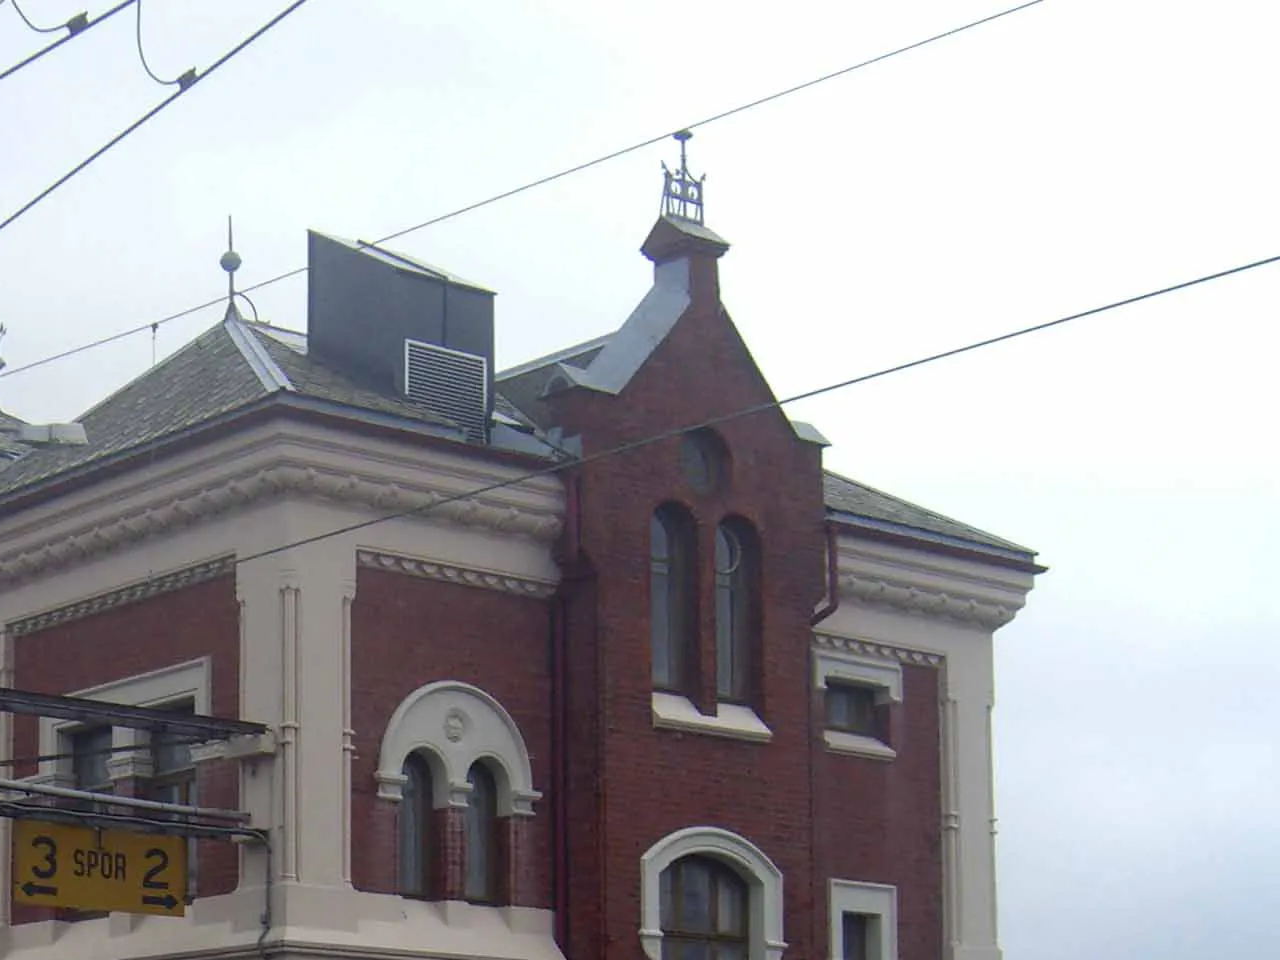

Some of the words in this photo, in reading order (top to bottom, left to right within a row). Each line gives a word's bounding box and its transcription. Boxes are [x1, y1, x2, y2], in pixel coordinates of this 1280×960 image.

[31, 836, 57, 879] 3
[73, 849, 127, 882] SPOR
[142, 848, 169, 889] 2
